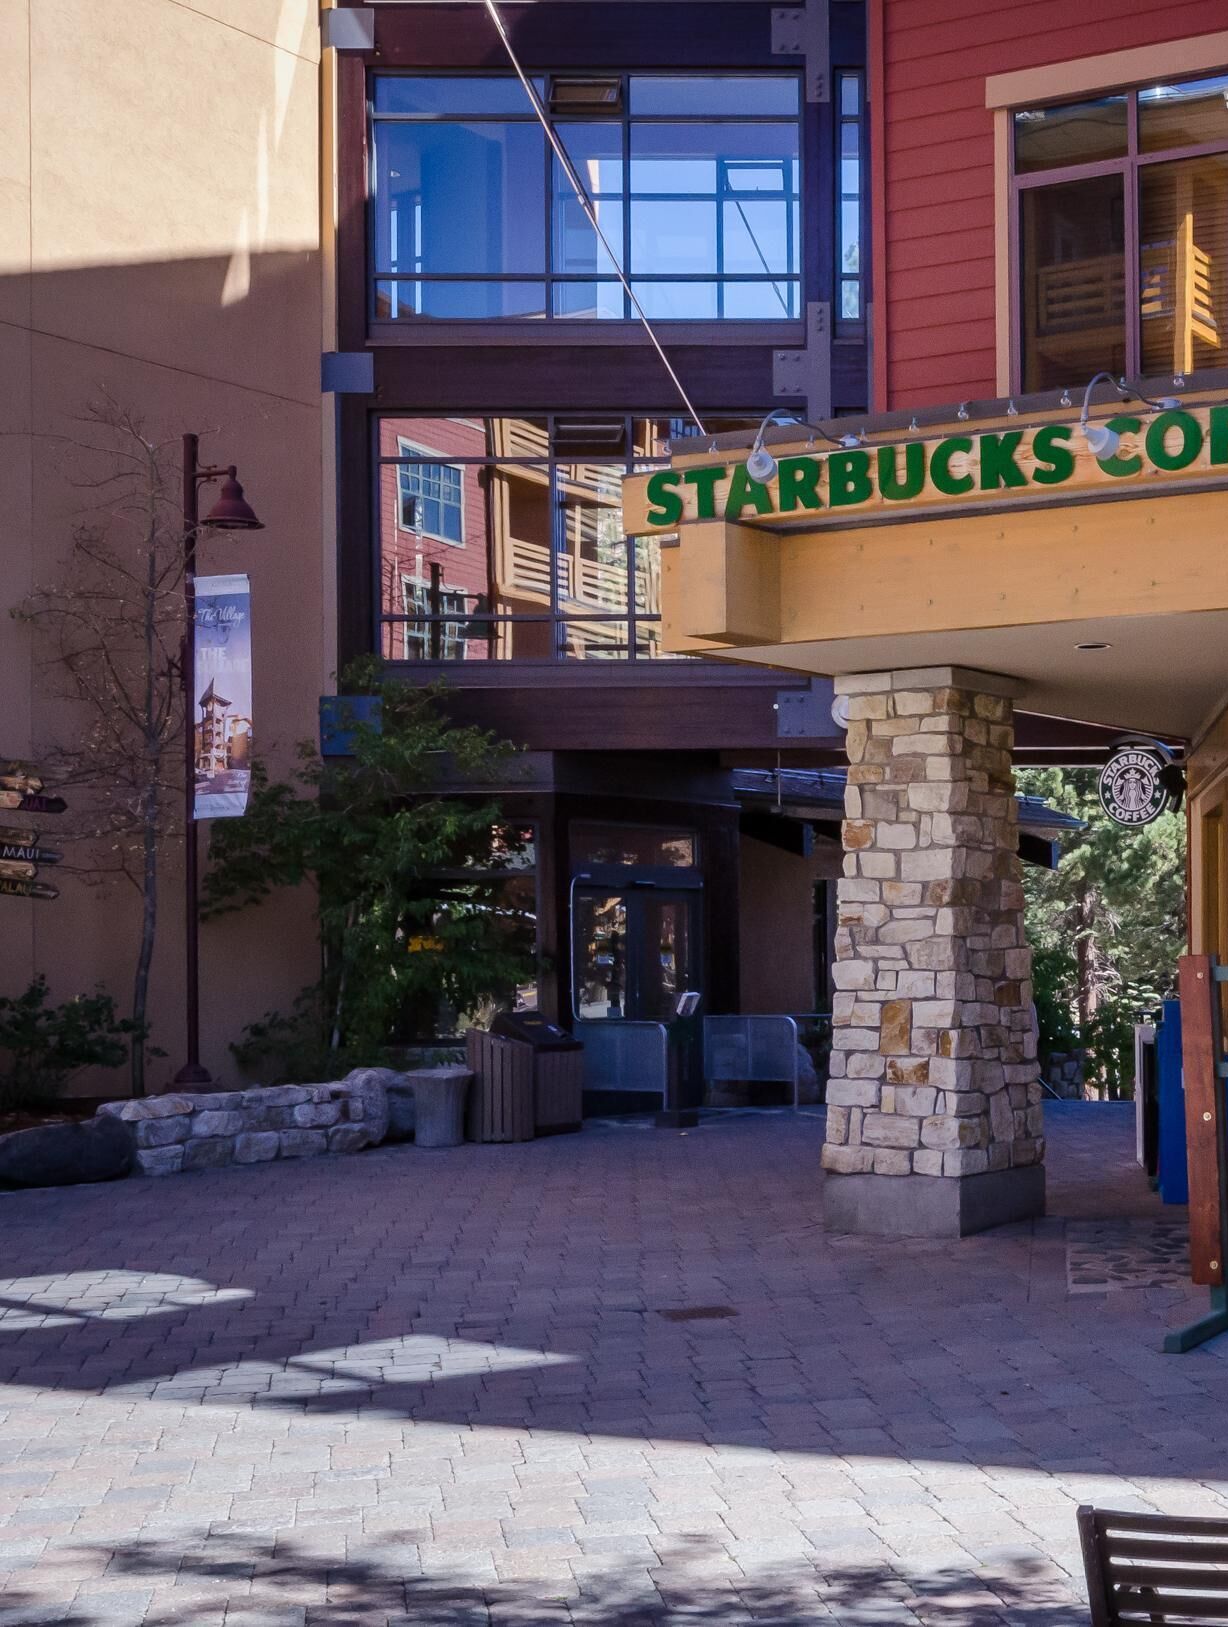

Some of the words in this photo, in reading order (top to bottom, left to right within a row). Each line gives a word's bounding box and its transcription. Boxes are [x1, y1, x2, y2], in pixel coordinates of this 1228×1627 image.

[647, 425, 1074, 526] STARBUCKS
[198, 608, 215, 622] The
[1108, 802, 1156, 822] COFFEE
[2, 845, 40, 859] MAUI
[0, 879, 32, 896] ALAU
